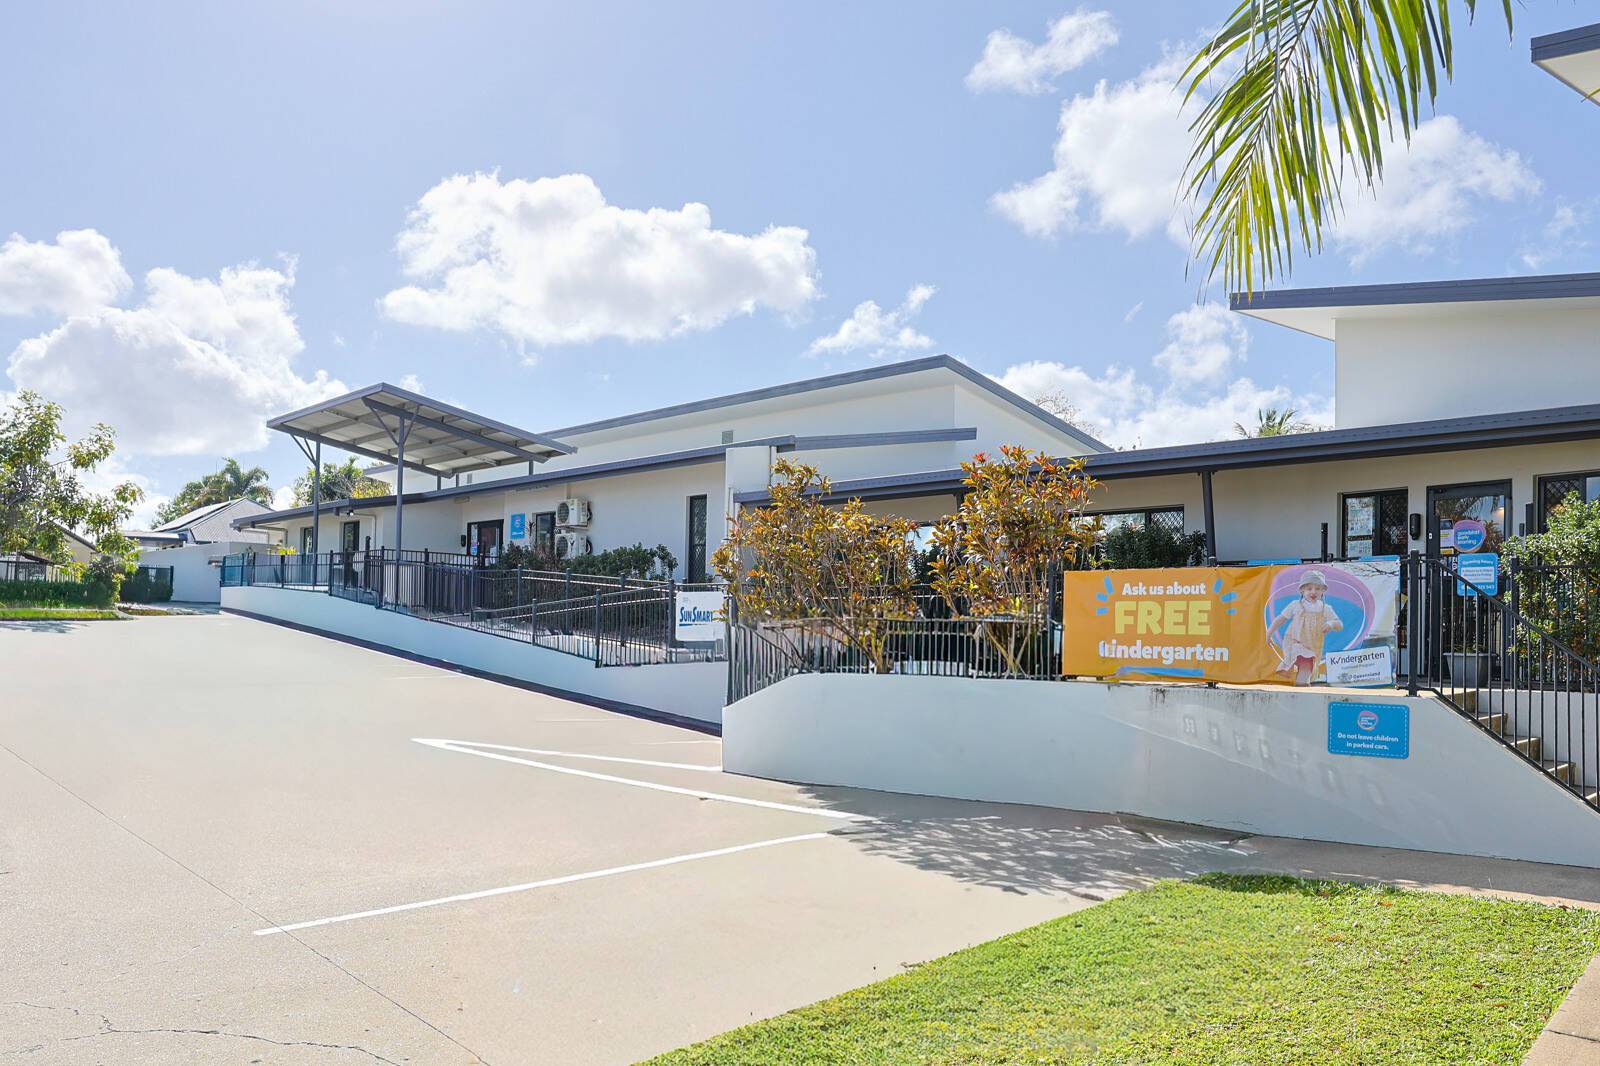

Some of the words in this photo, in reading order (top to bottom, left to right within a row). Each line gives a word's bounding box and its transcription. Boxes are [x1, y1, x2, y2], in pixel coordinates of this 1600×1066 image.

[1122, 582, 1147, 595] Ask
[1149, 585, 1164, 595] us
[1166, 581, 1206, 595] about
[1114, 600, 1212, 636] FREE
[1373, 734, 1399, 742] children
